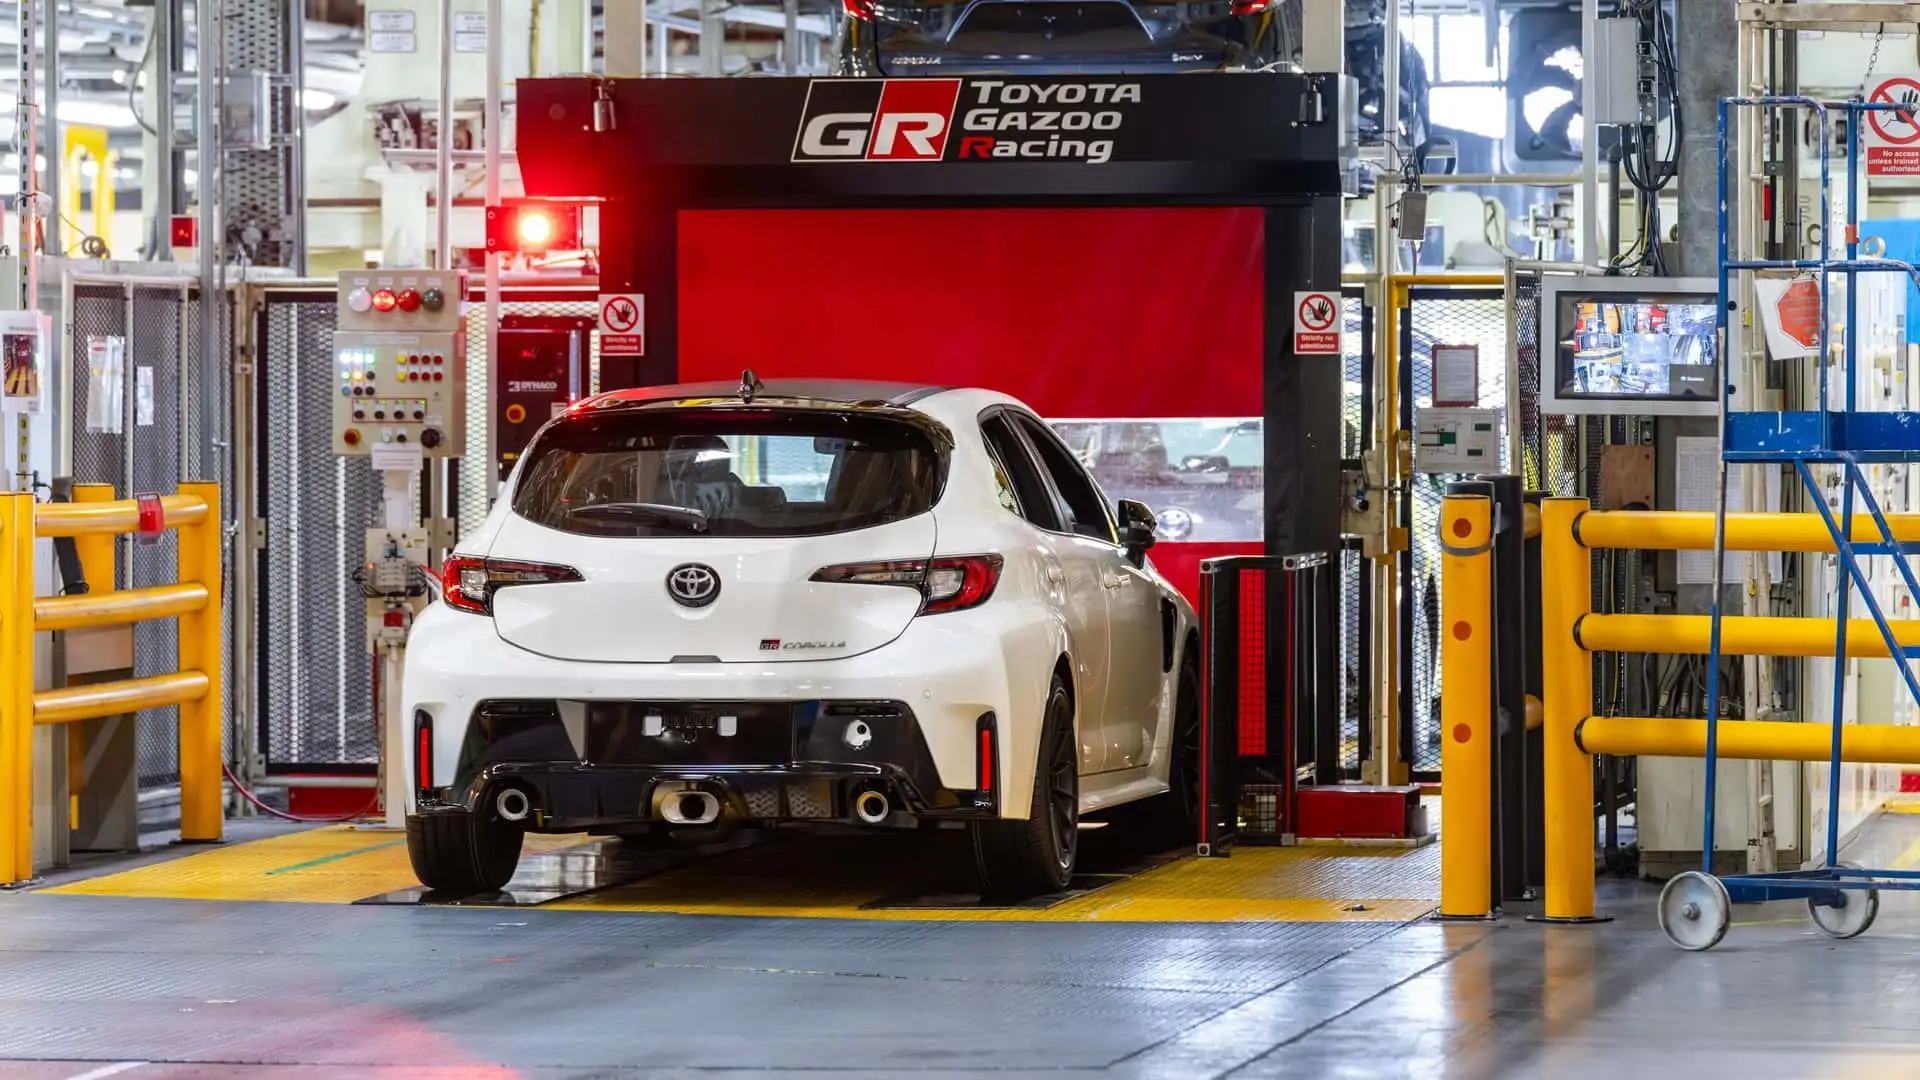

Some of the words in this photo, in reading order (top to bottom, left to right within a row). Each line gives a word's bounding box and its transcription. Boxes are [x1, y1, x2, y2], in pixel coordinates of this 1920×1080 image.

[970, 80, 1142, 104] TOYOTA
[962, 108, 1123, 131] GAZOO
[800, 112, 946, 156] GR
[958, 134, 1115, 164] Racing
[605, 336, 627, 344] Strictly
